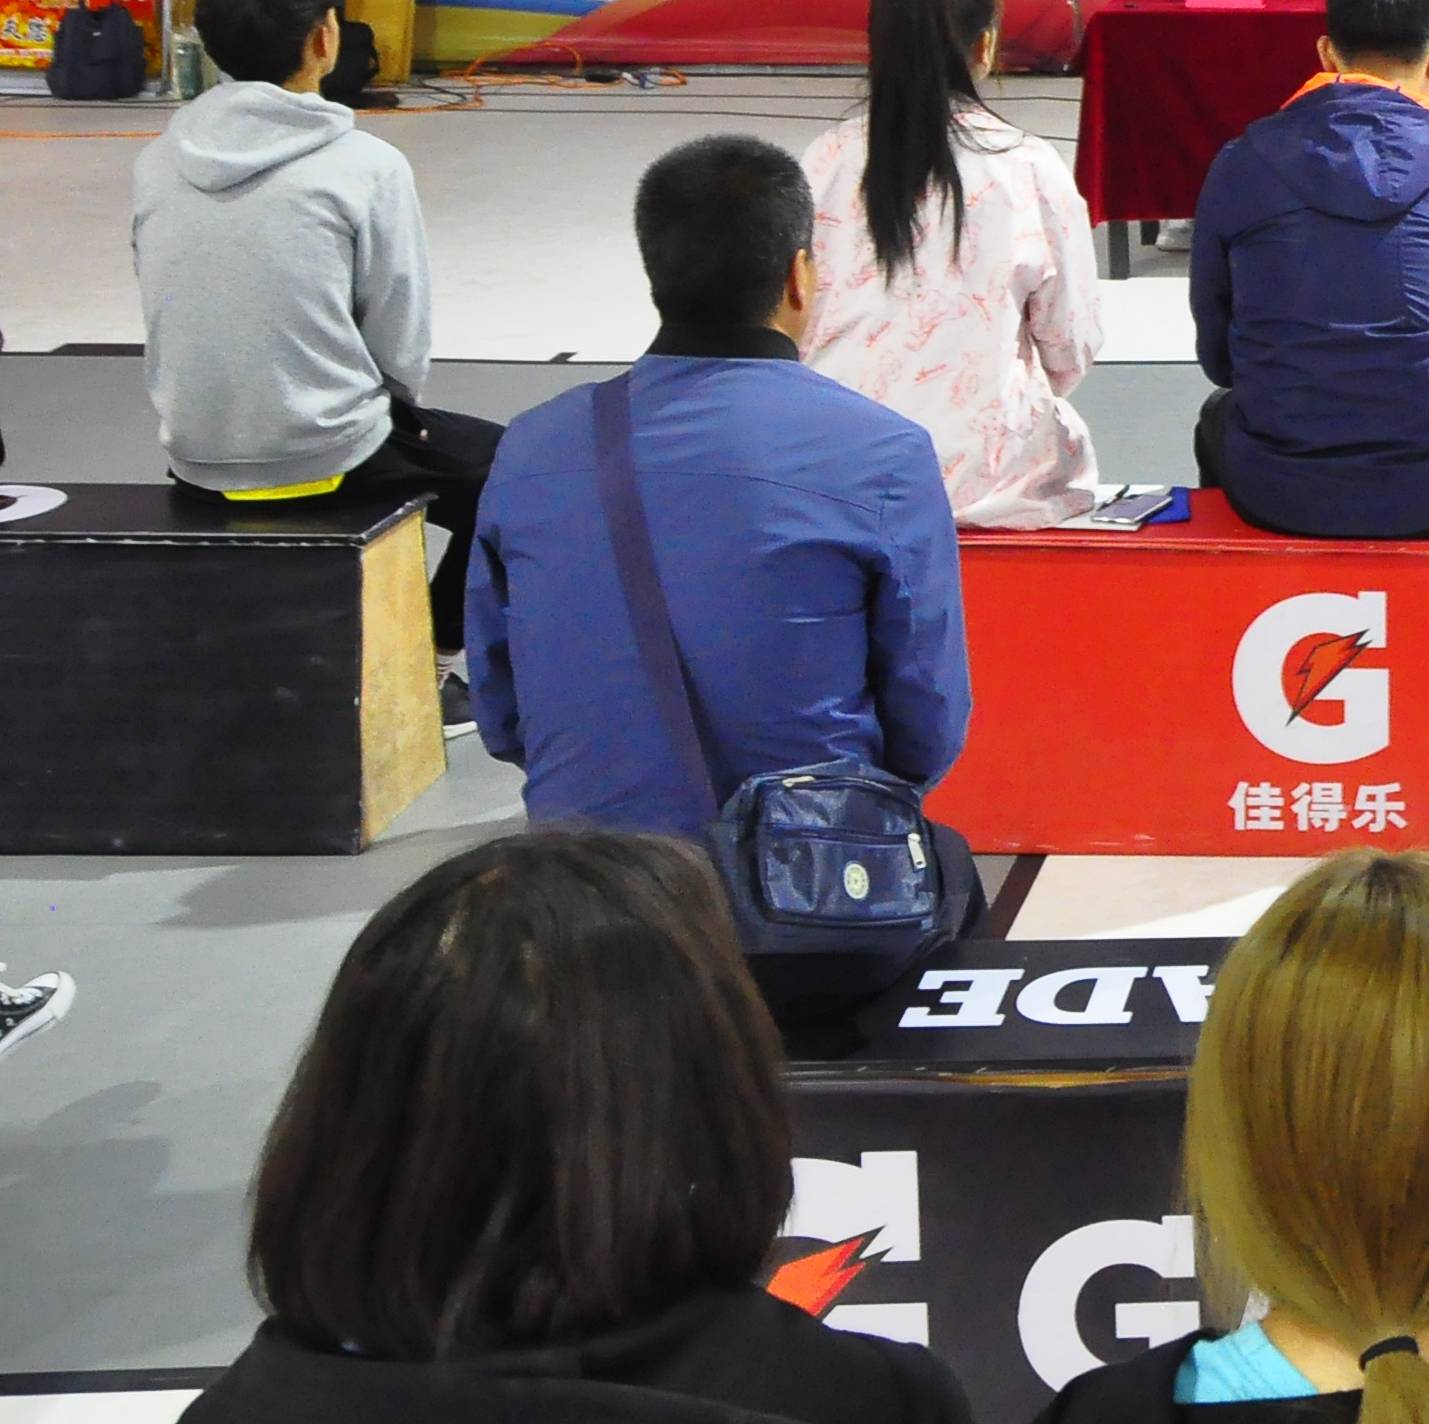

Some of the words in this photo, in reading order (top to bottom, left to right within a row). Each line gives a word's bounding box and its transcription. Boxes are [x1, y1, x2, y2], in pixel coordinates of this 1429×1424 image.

[1231, 590, 1390, 765] G
[1227, 782, 1408, 833] 佳得乐
